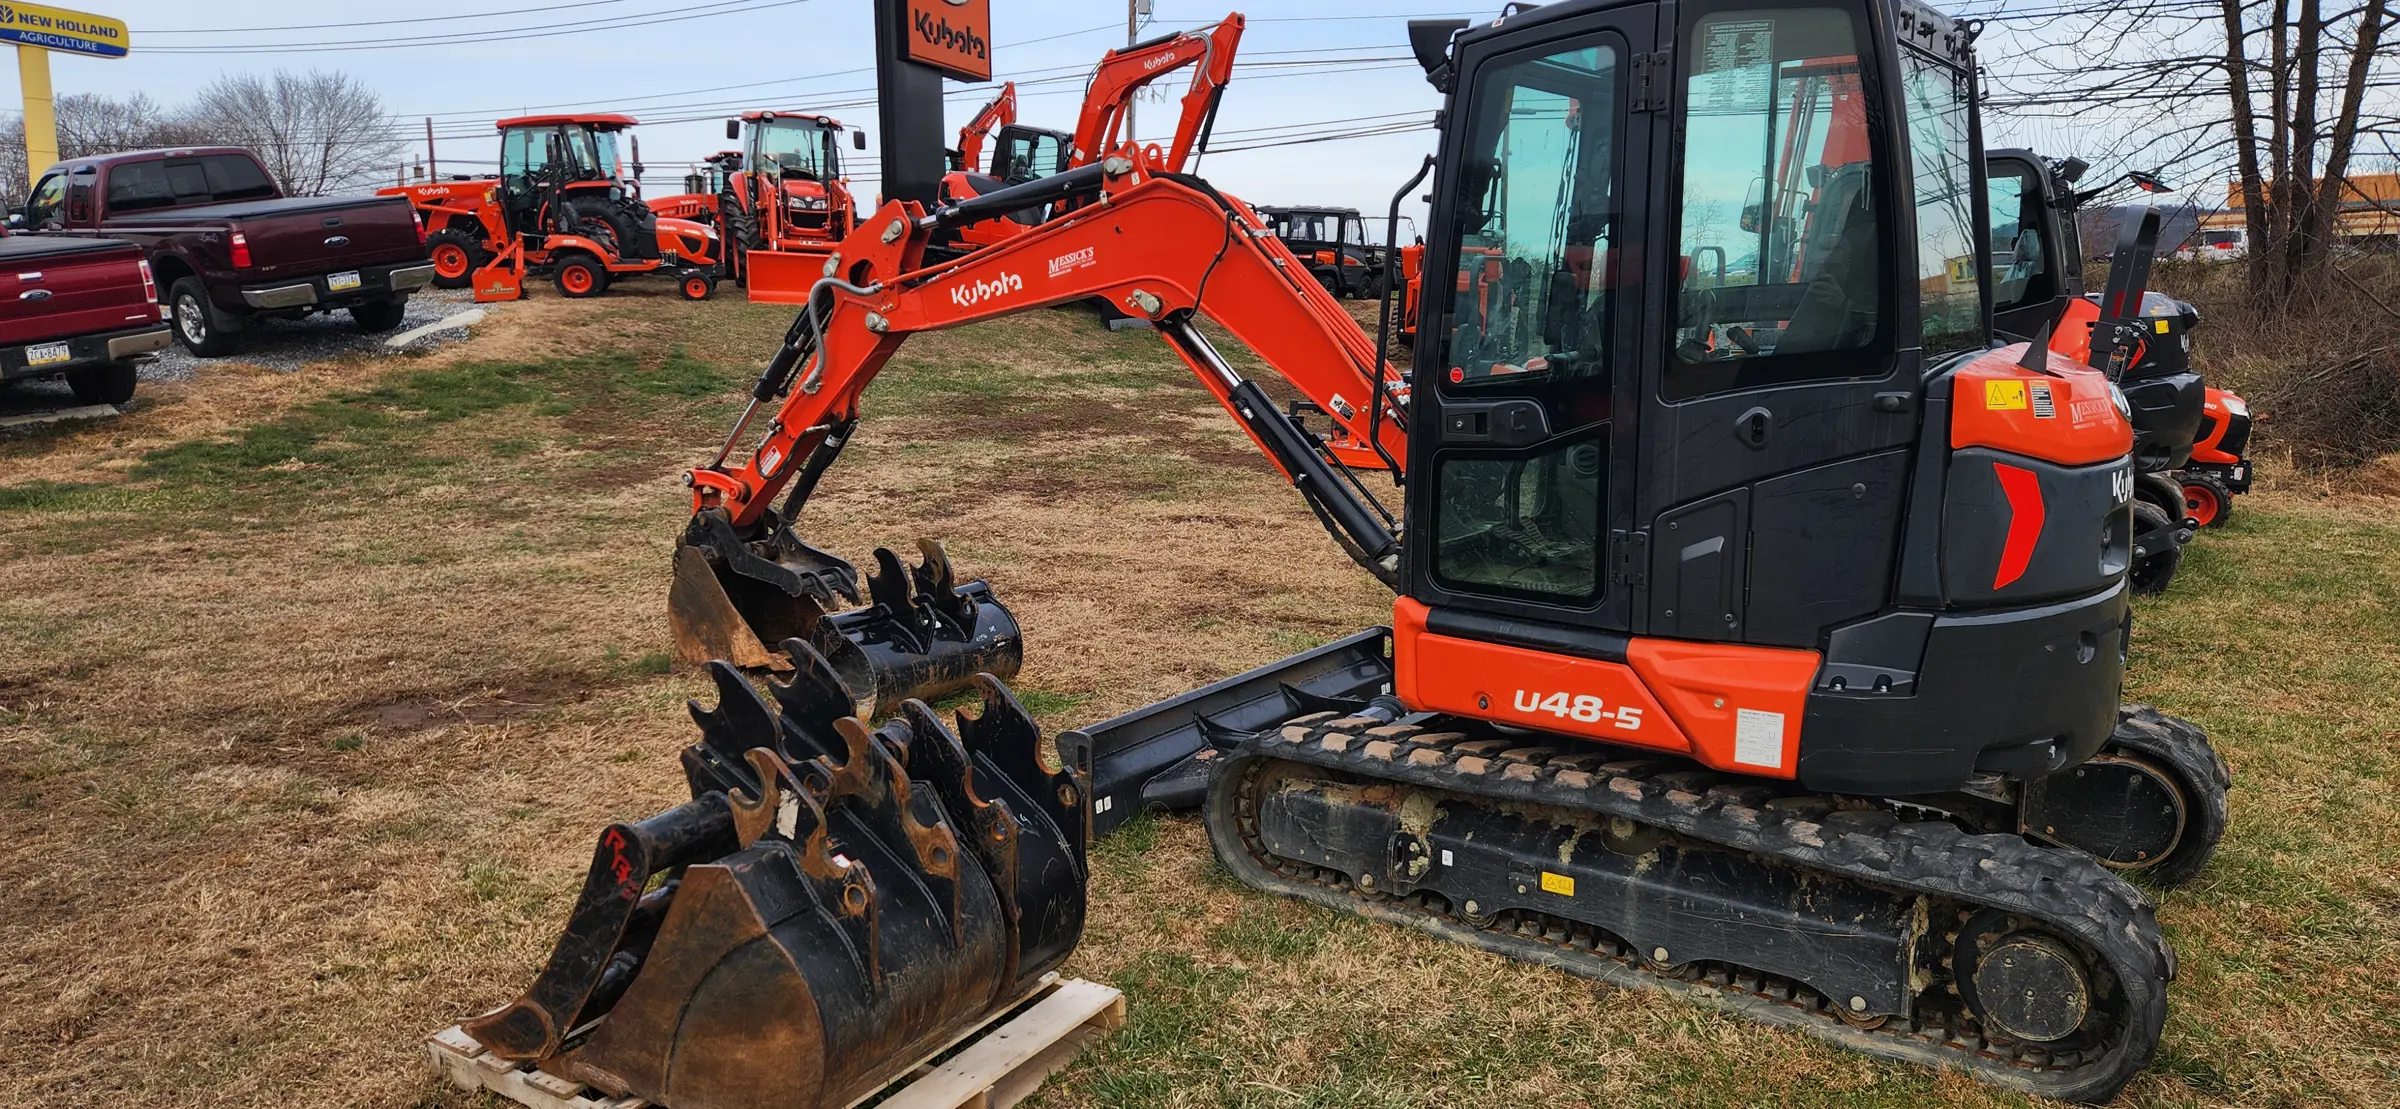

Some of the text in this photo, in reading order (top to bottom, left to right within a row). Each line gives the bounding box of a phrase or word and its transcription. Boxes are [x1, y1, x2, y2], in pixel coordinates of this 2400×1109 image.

[18, 12, 119, 39] NEW HOLLAND
[914, 8, 986, 60] Kubota
[19, 31, 99, 52] AGRICULTURE
[1143, 52, 1175, 70] Kubota
[417, 186, 450, 196] Kubota
[1048, 246, 1095, 275] MESSICK'S
[950, 271, 1024, 307] Kubota
[1513, 689, 1643, 731] U48-5
